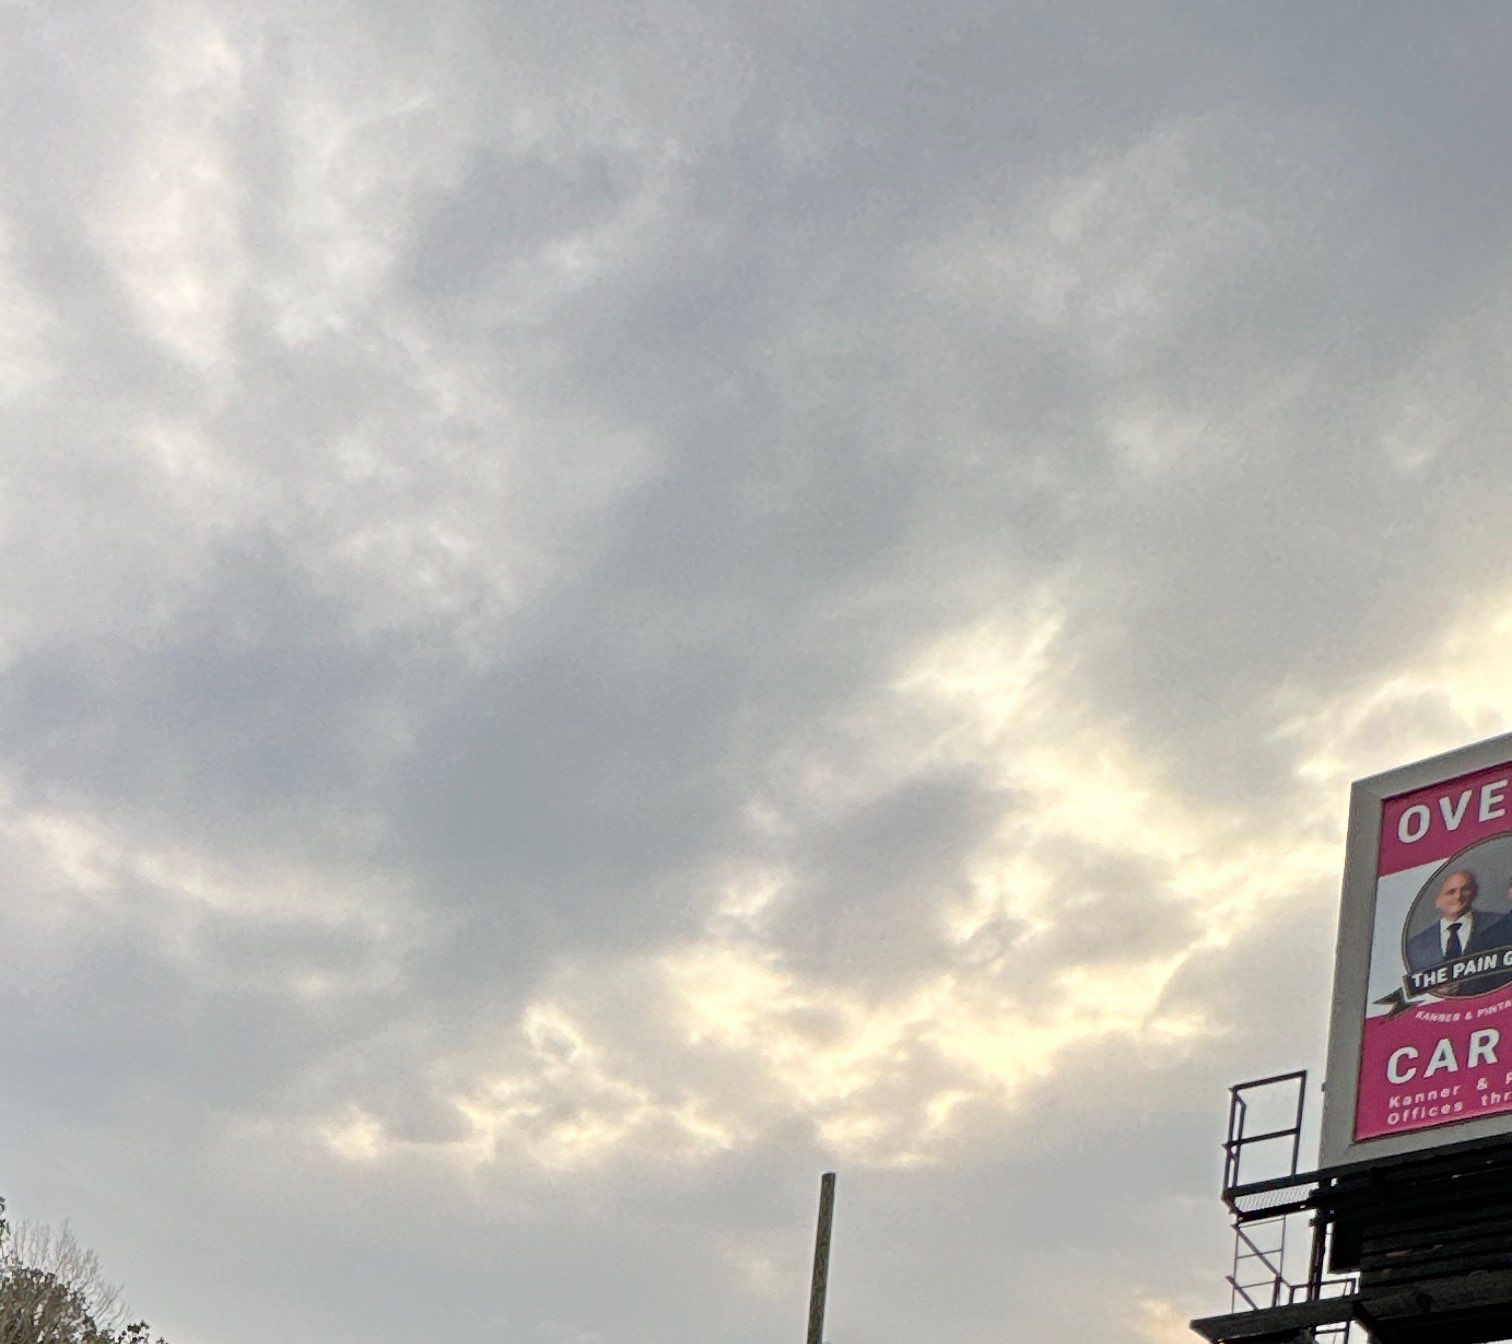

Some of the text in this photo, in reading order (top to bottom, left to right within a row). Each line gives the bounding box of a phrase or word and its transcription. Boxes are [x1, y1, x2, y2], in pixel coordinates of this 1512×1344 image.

[1397, 779, 1509, 844] OVE
[1411, 967, 1448, 988] THE
[1452, 953, 1497, 979] PAIN
[1386, 1028, 1500, 1085] CAR
[1388, 1085, 1461, 1109] Kanner
[1476, 1077, 1488, 1091] &
[1387, 1101, 1463, 1125] Offices
